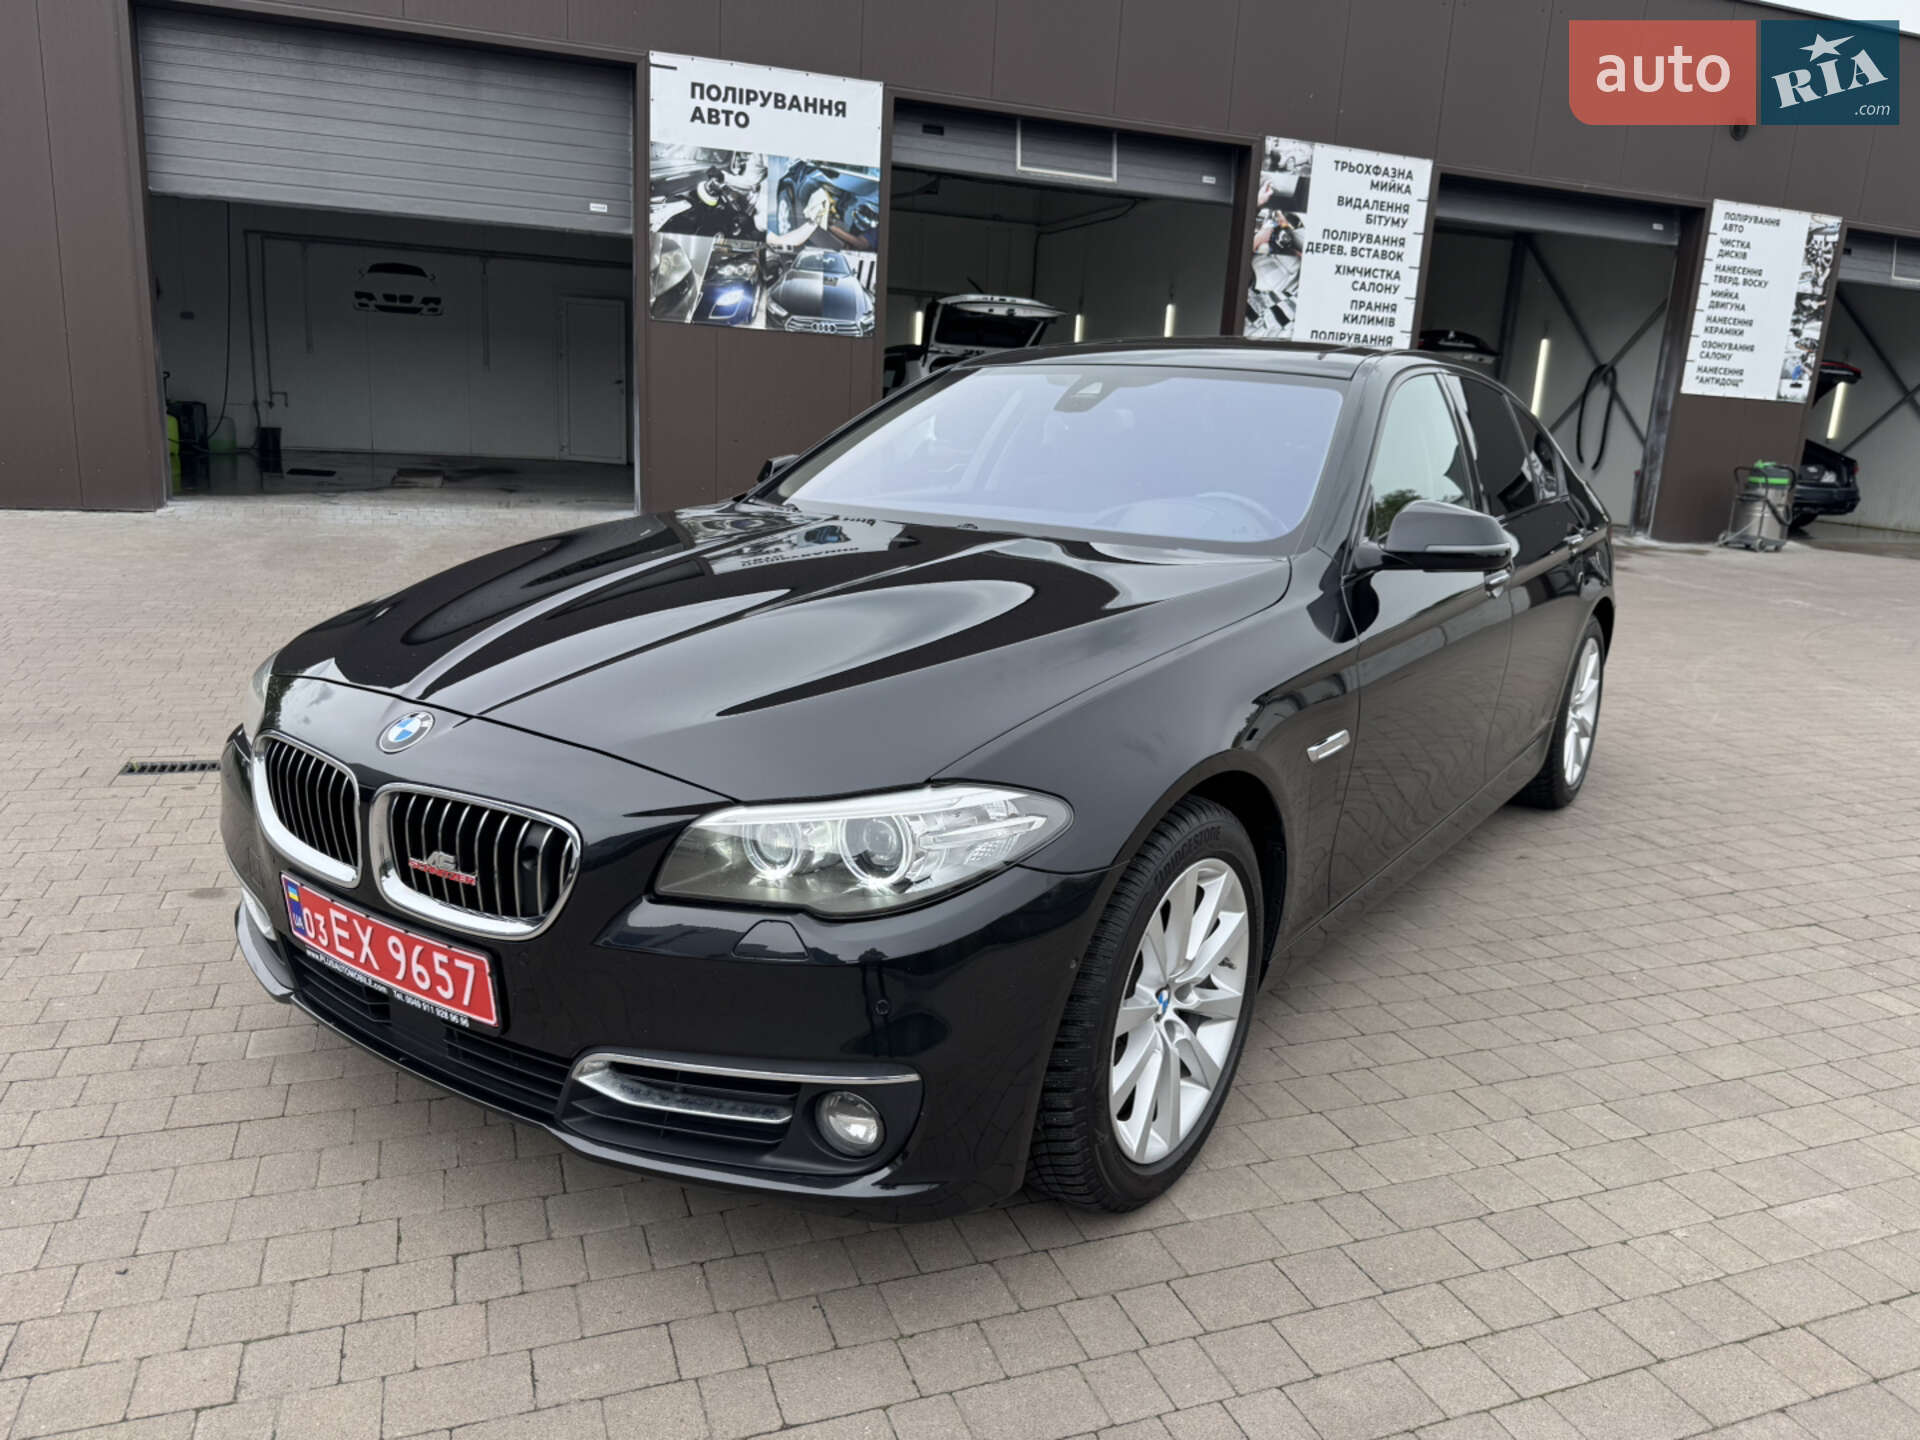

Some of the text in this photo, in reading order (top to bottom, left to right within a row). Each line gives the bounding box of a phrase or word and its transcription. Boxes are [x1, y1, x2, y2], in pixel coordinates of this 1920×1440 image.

[691, 82, 847, 118] ПОЛІРУВАННЯ
[690, 106, 750, 128] АВТО
[1334, 160, 1413, 180] ТРЬОХФАЗНА
[1370, 180, 1412, 195] МИЙКА
[1337, 195, 1410, 214] ВИДАЛЕННЯ
[1365, 214, 1408, 229] БІТУМУ
[1724, 212, 1780, 227] ПОЛІРУВАННЯ
[1722, 223, 1744, 233] АВТО
[1322, 228, 1406, 248] ПОЛІРУВАННЯ
[1720, 239, 1751, 249] ЧИСТКА
[1305, 242, 1404, 262] ДЕРЕВ. ВСТАВОК
[1717, 249, 1747, 260] ДИСКІВ
[1334, 264, 1401, 281] ХІМЧИСТКА
[1715, 264, 1763, 277] НАНЕСЕННЯ
[1351, 280, 1400, 295] САЛОНУ
[1742, 277, 1769, 289] ВОСКУ
[1711, 290, 1739, 300] МИЙКА
[1350, 299, 1397, 313] ПРАННЯ
[1708, 300, 1746, 312] ДВИГУНА
[1342, 313, 1395, 328] КИЛИМІВ
[1706, 315, 1753, 327] НАНЕСЕННЯ
[1704, 326, 1744, 337] КЕРАМІКИ
[1702, 340, 1755, 352] ОЗОНУВАННЯ
[1700, 351, 1732, 361] САЛОНУ
[1697, 366, 1744, 376] НАНЕСЕННЯ
[387, 935, 475, 1006] 9657
